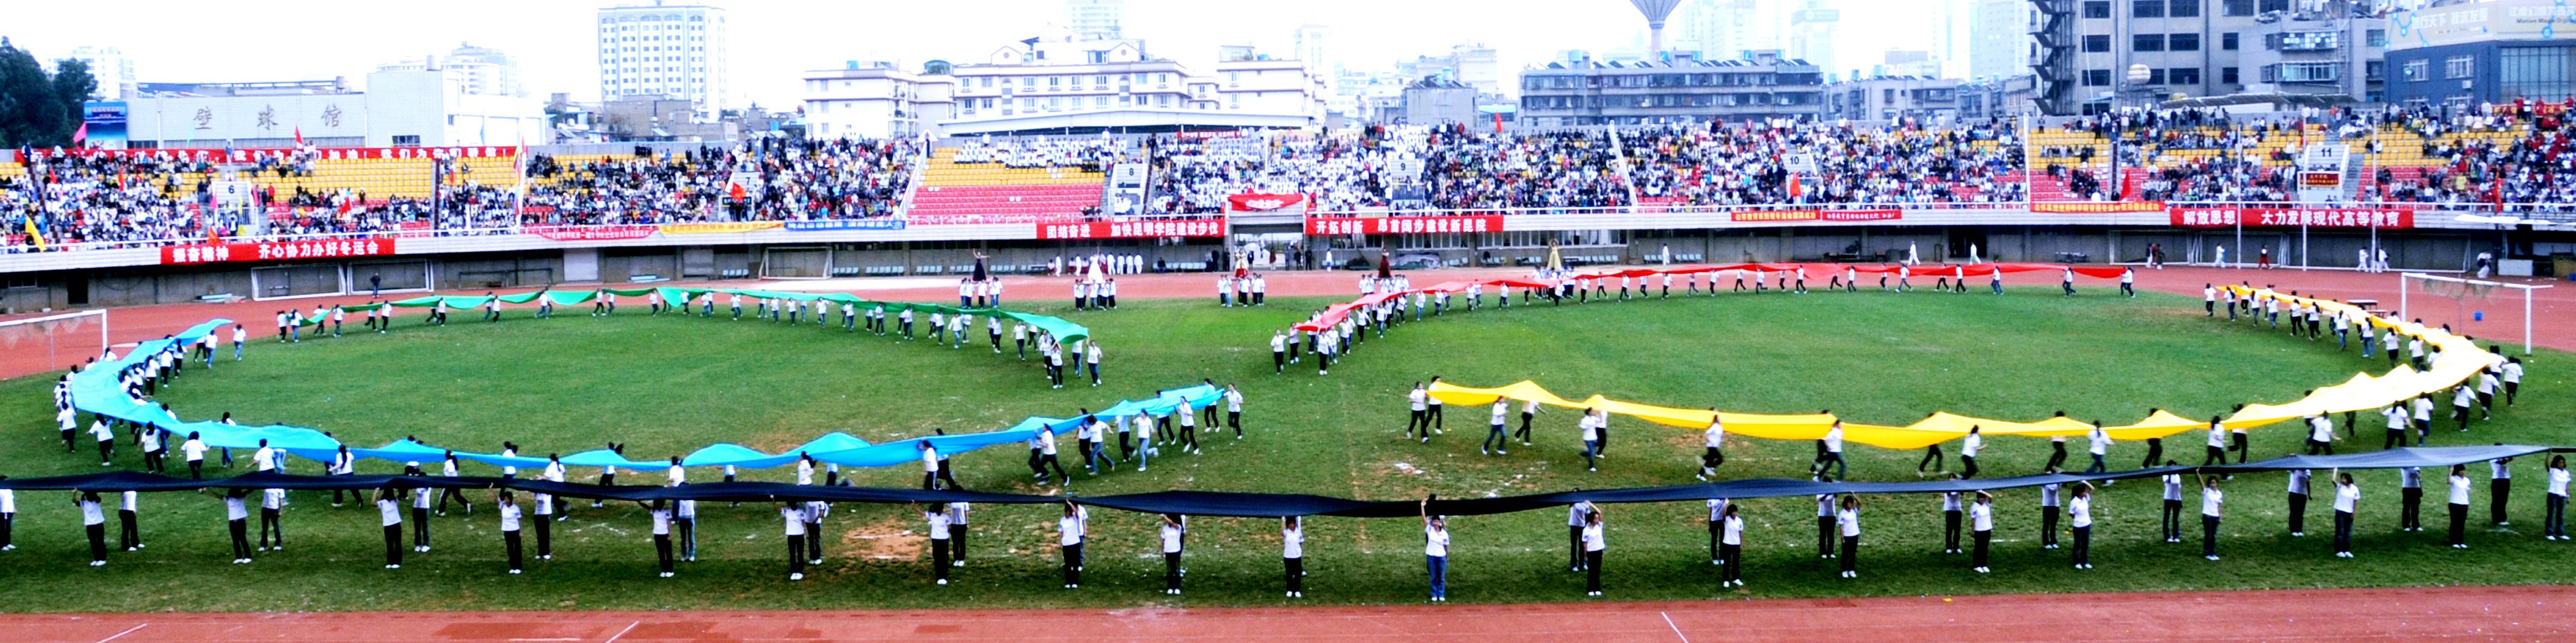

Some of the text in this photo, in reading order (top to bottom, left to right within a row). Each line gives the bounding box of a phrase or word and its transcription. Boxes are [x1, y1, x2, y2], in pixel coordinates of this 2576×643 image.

[194, 103, 342, 130] 壁球馆
[2321, 147, 2331, 157] 11
[1790, 156, 1799, 164] 10
[1129, 167, 1134, 176] 8
[745, 177, 751, 185] 7
[228, 185, 235, 194] 6
[2183, 210, 2400, 227] 解放思想 大力发展现代高等教育
[1046, 222, 1218, 239] 团结奋进 加快昆明学院建设步伐
[1316, 219, 1487, 234] 开拓创新 昂首阔步建设新昆院
[173, 241, 379, 263] 振奋精神 齐心协力办好冬运会
